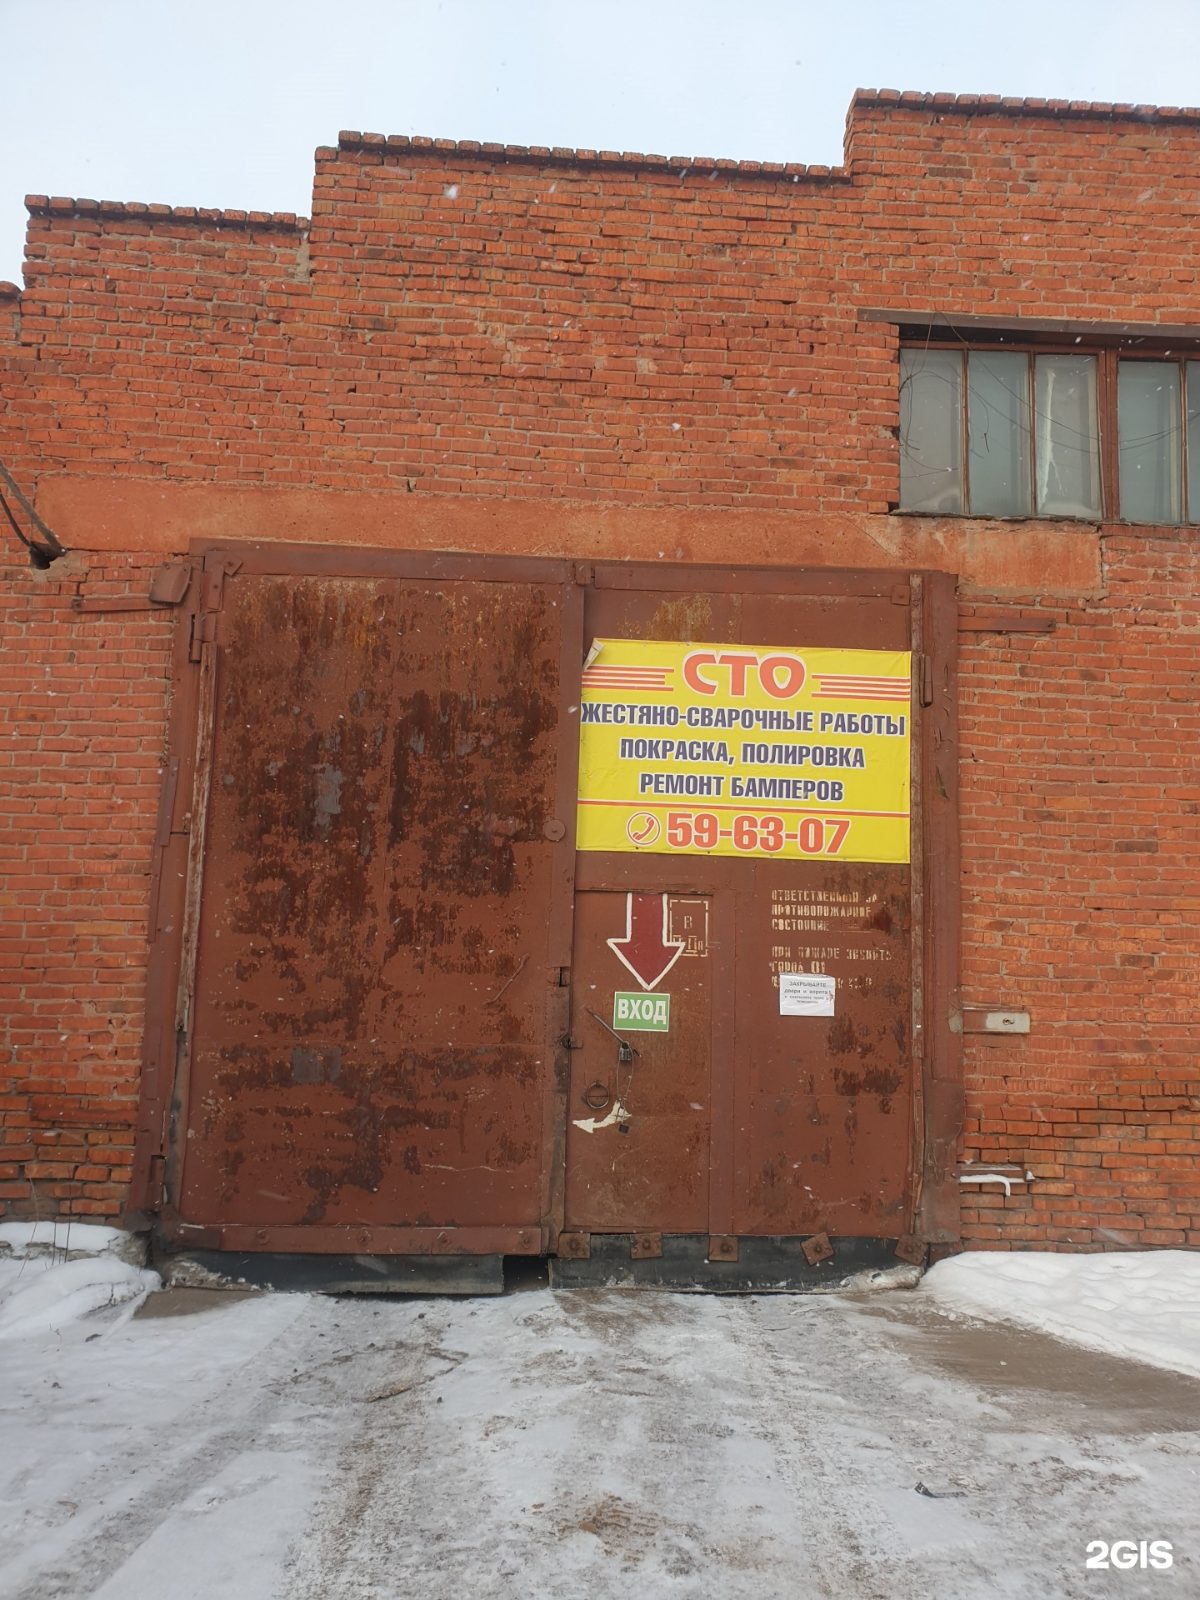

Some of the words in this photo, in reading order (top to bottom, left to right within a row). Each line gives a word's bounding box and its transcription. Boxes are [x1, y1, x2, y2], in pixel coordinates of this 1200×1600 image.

[683, 650, 805, 698] СТО
[581, 703, 813, 731] ЖЕСТЯНО-СВАРОЧНЫЕ
[820, 713, 906, 736] РАБОТЫ
[620, 738, 734, 765] ПОКРАСКА,
[742, 743, 865, 768] ПОЛИРОВКА
[640, 774, 724, 796] РЕМОНТ
[731, 777, 843, 801] БАМПЕРОВ
[667, 812, 850, 854] 59-63-07
[617, 999, 667, 1025] ВХОД
